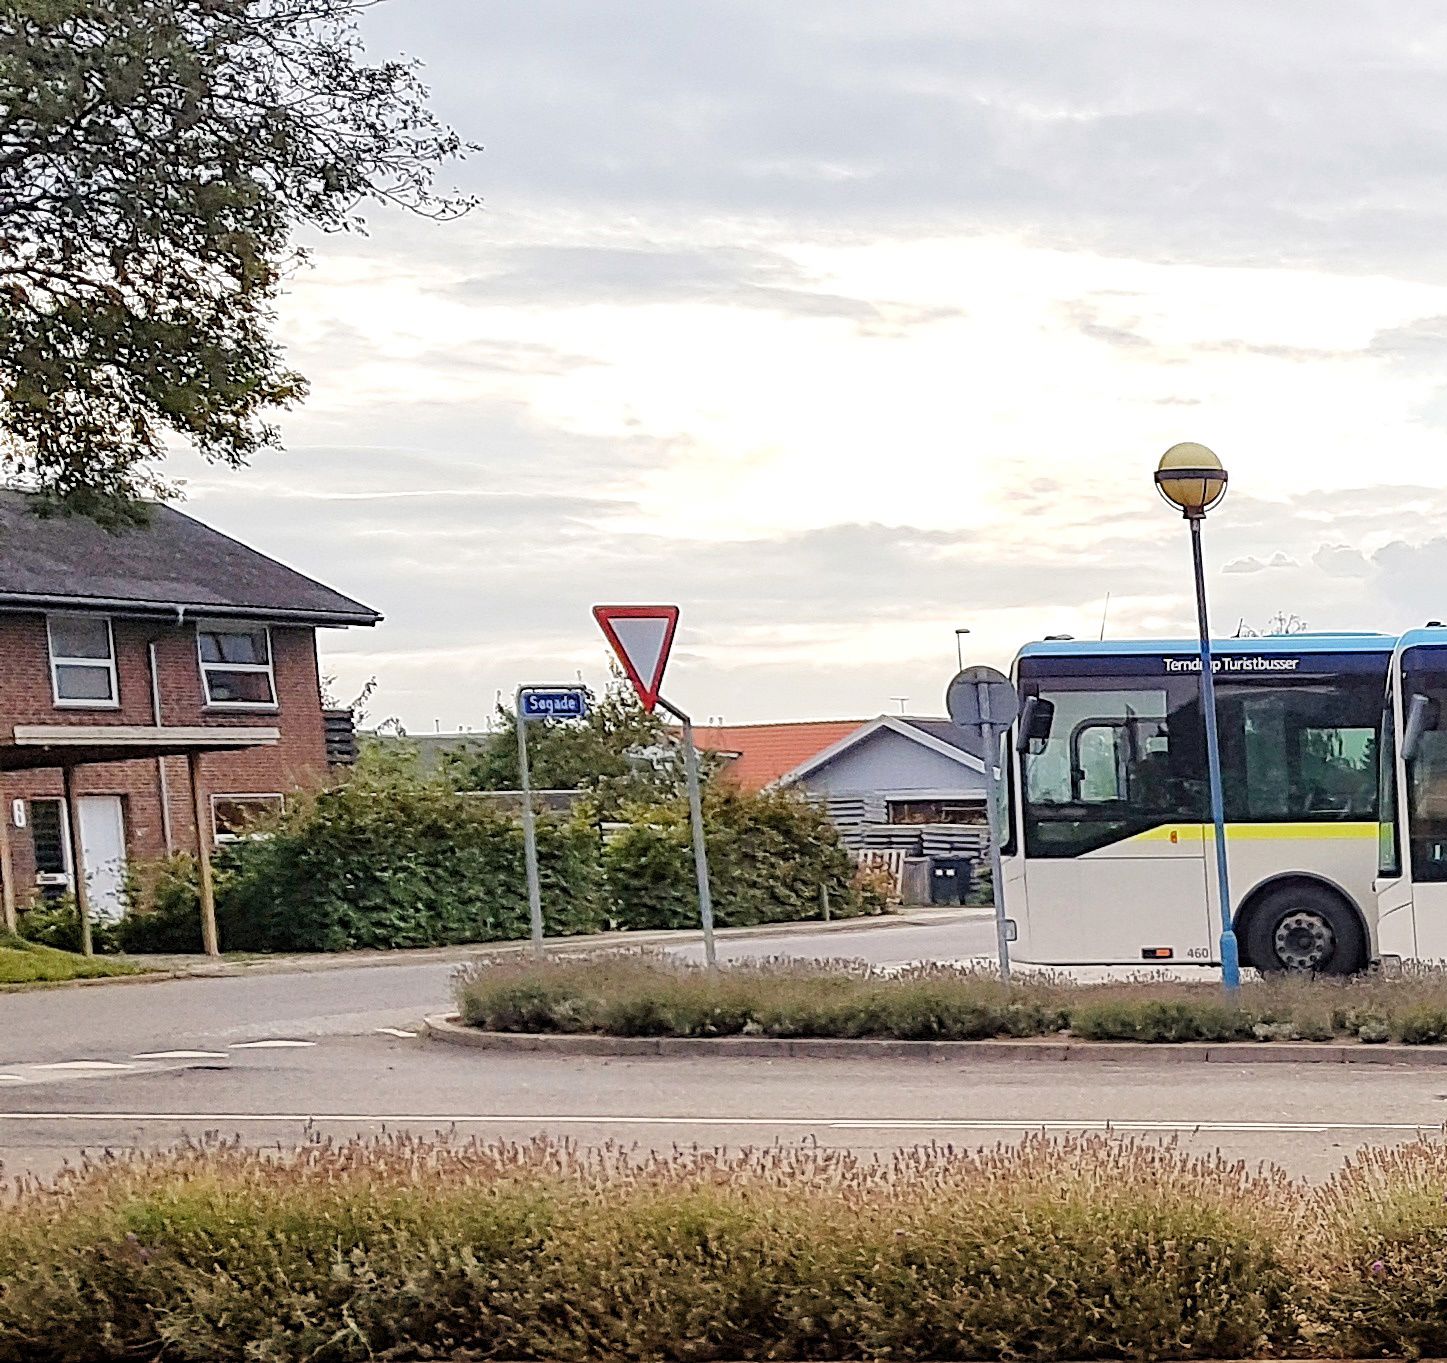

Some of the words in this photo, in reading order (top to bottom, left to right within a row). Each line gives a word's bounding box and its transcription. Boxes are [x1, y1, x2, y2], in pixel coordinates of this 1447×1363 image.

[1163, 657, 1221, 673] Terndrp
[1221, 656, 1299, 671] Turistbusser
[529, 695, 576, 714] Søgade
[1187, 947, 1209, 959] 460
